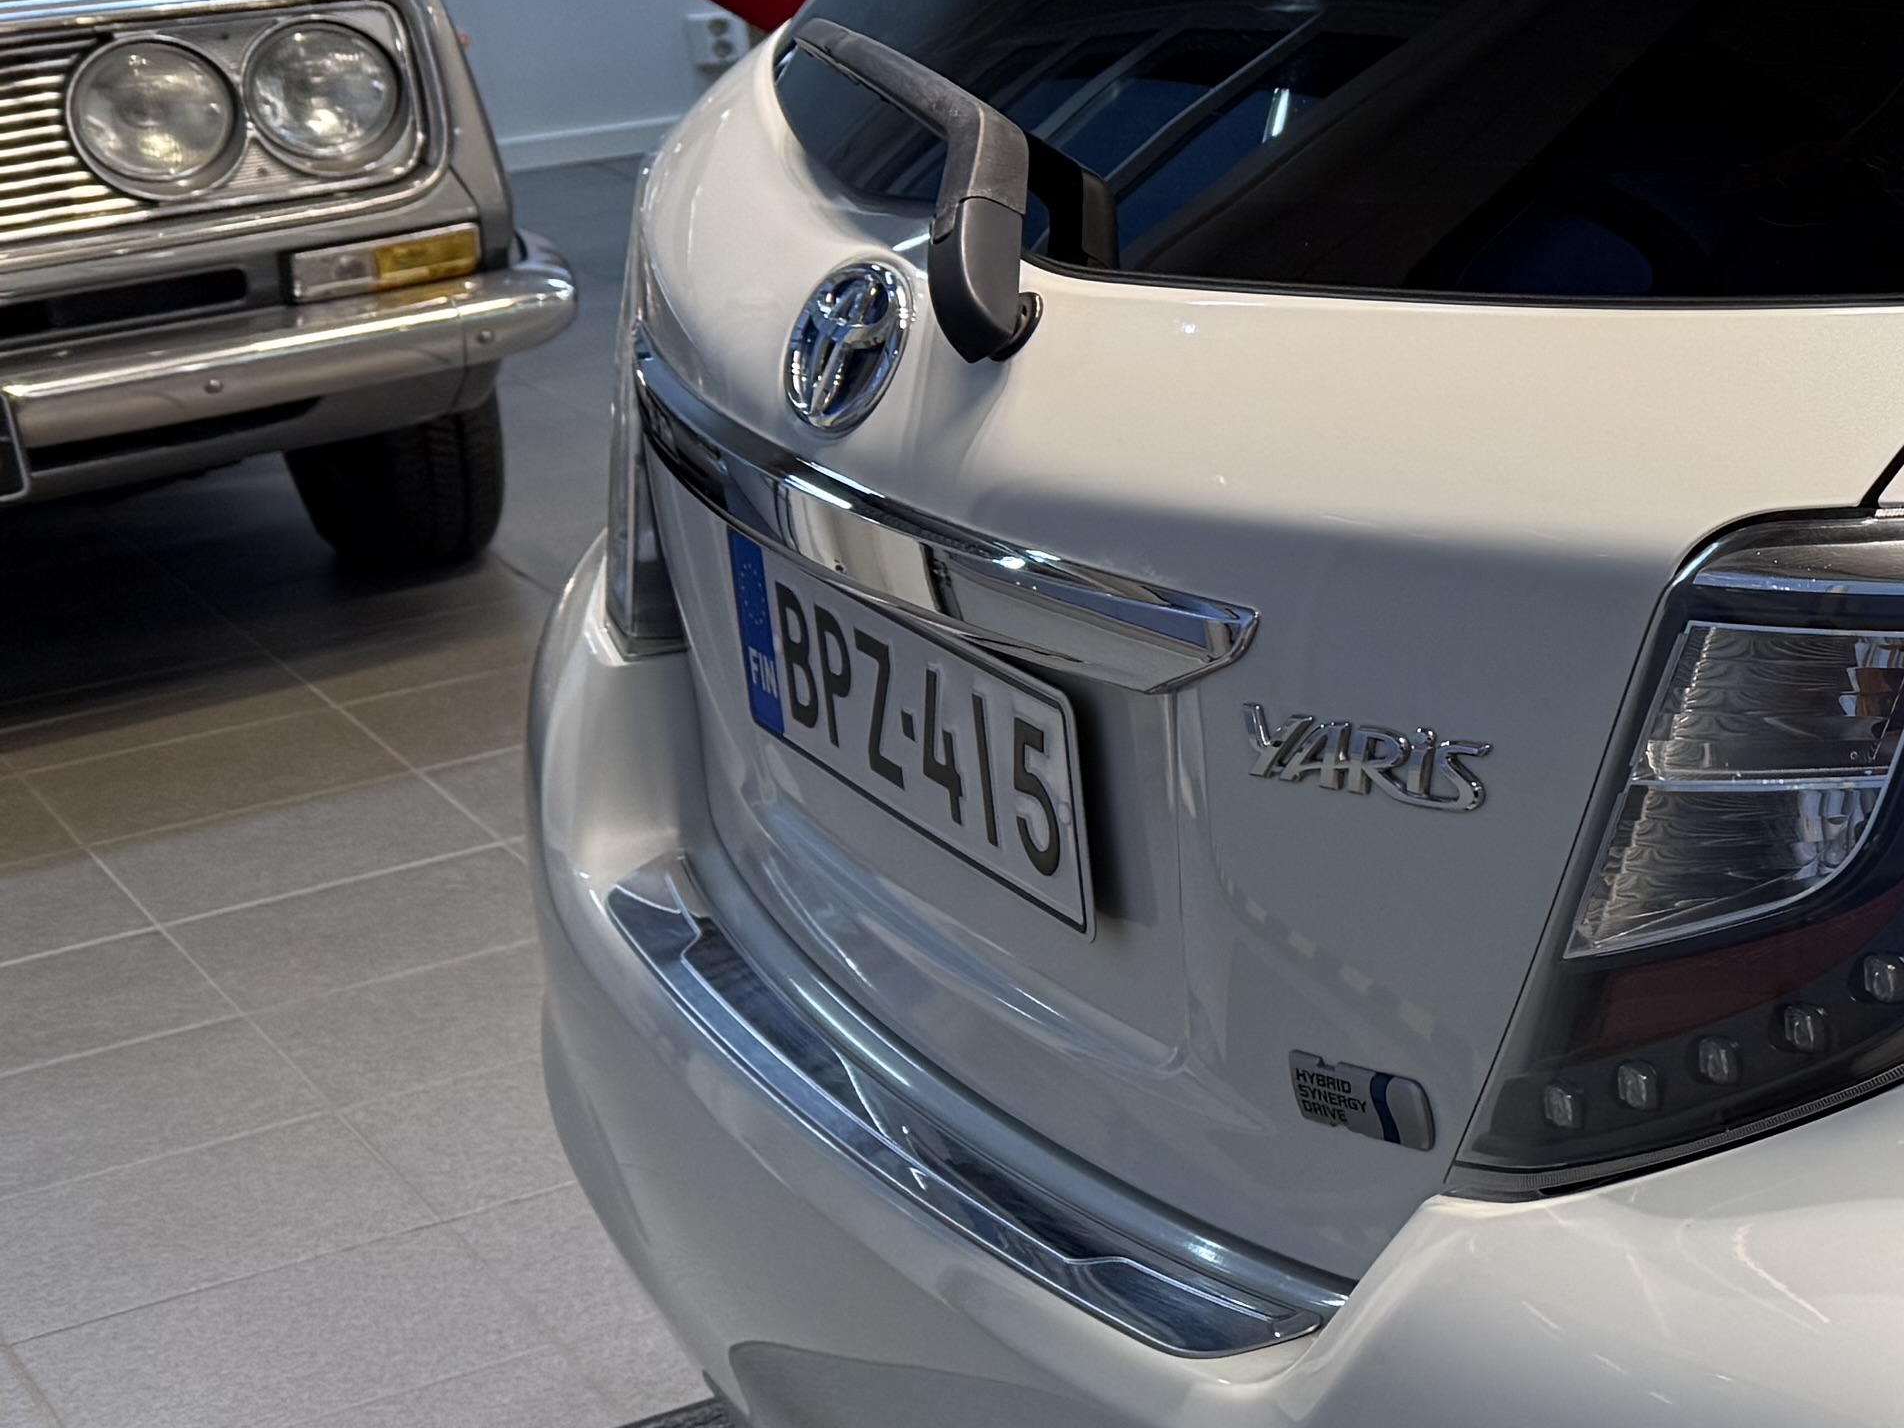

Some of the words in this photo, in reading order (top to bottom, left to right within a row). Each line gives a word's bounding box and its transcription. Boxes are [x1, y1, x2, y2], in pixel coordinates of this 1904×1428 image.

[747, 644, 779, 699] FIN
[775, 580, 1061, 877] BPZ-415
[1295, 1068, 1352, 1094] HYBRID
[1297, 1084, 1367, 1113] SYNERGY
[1302, 1098, 1348, 1123] DRIVE
